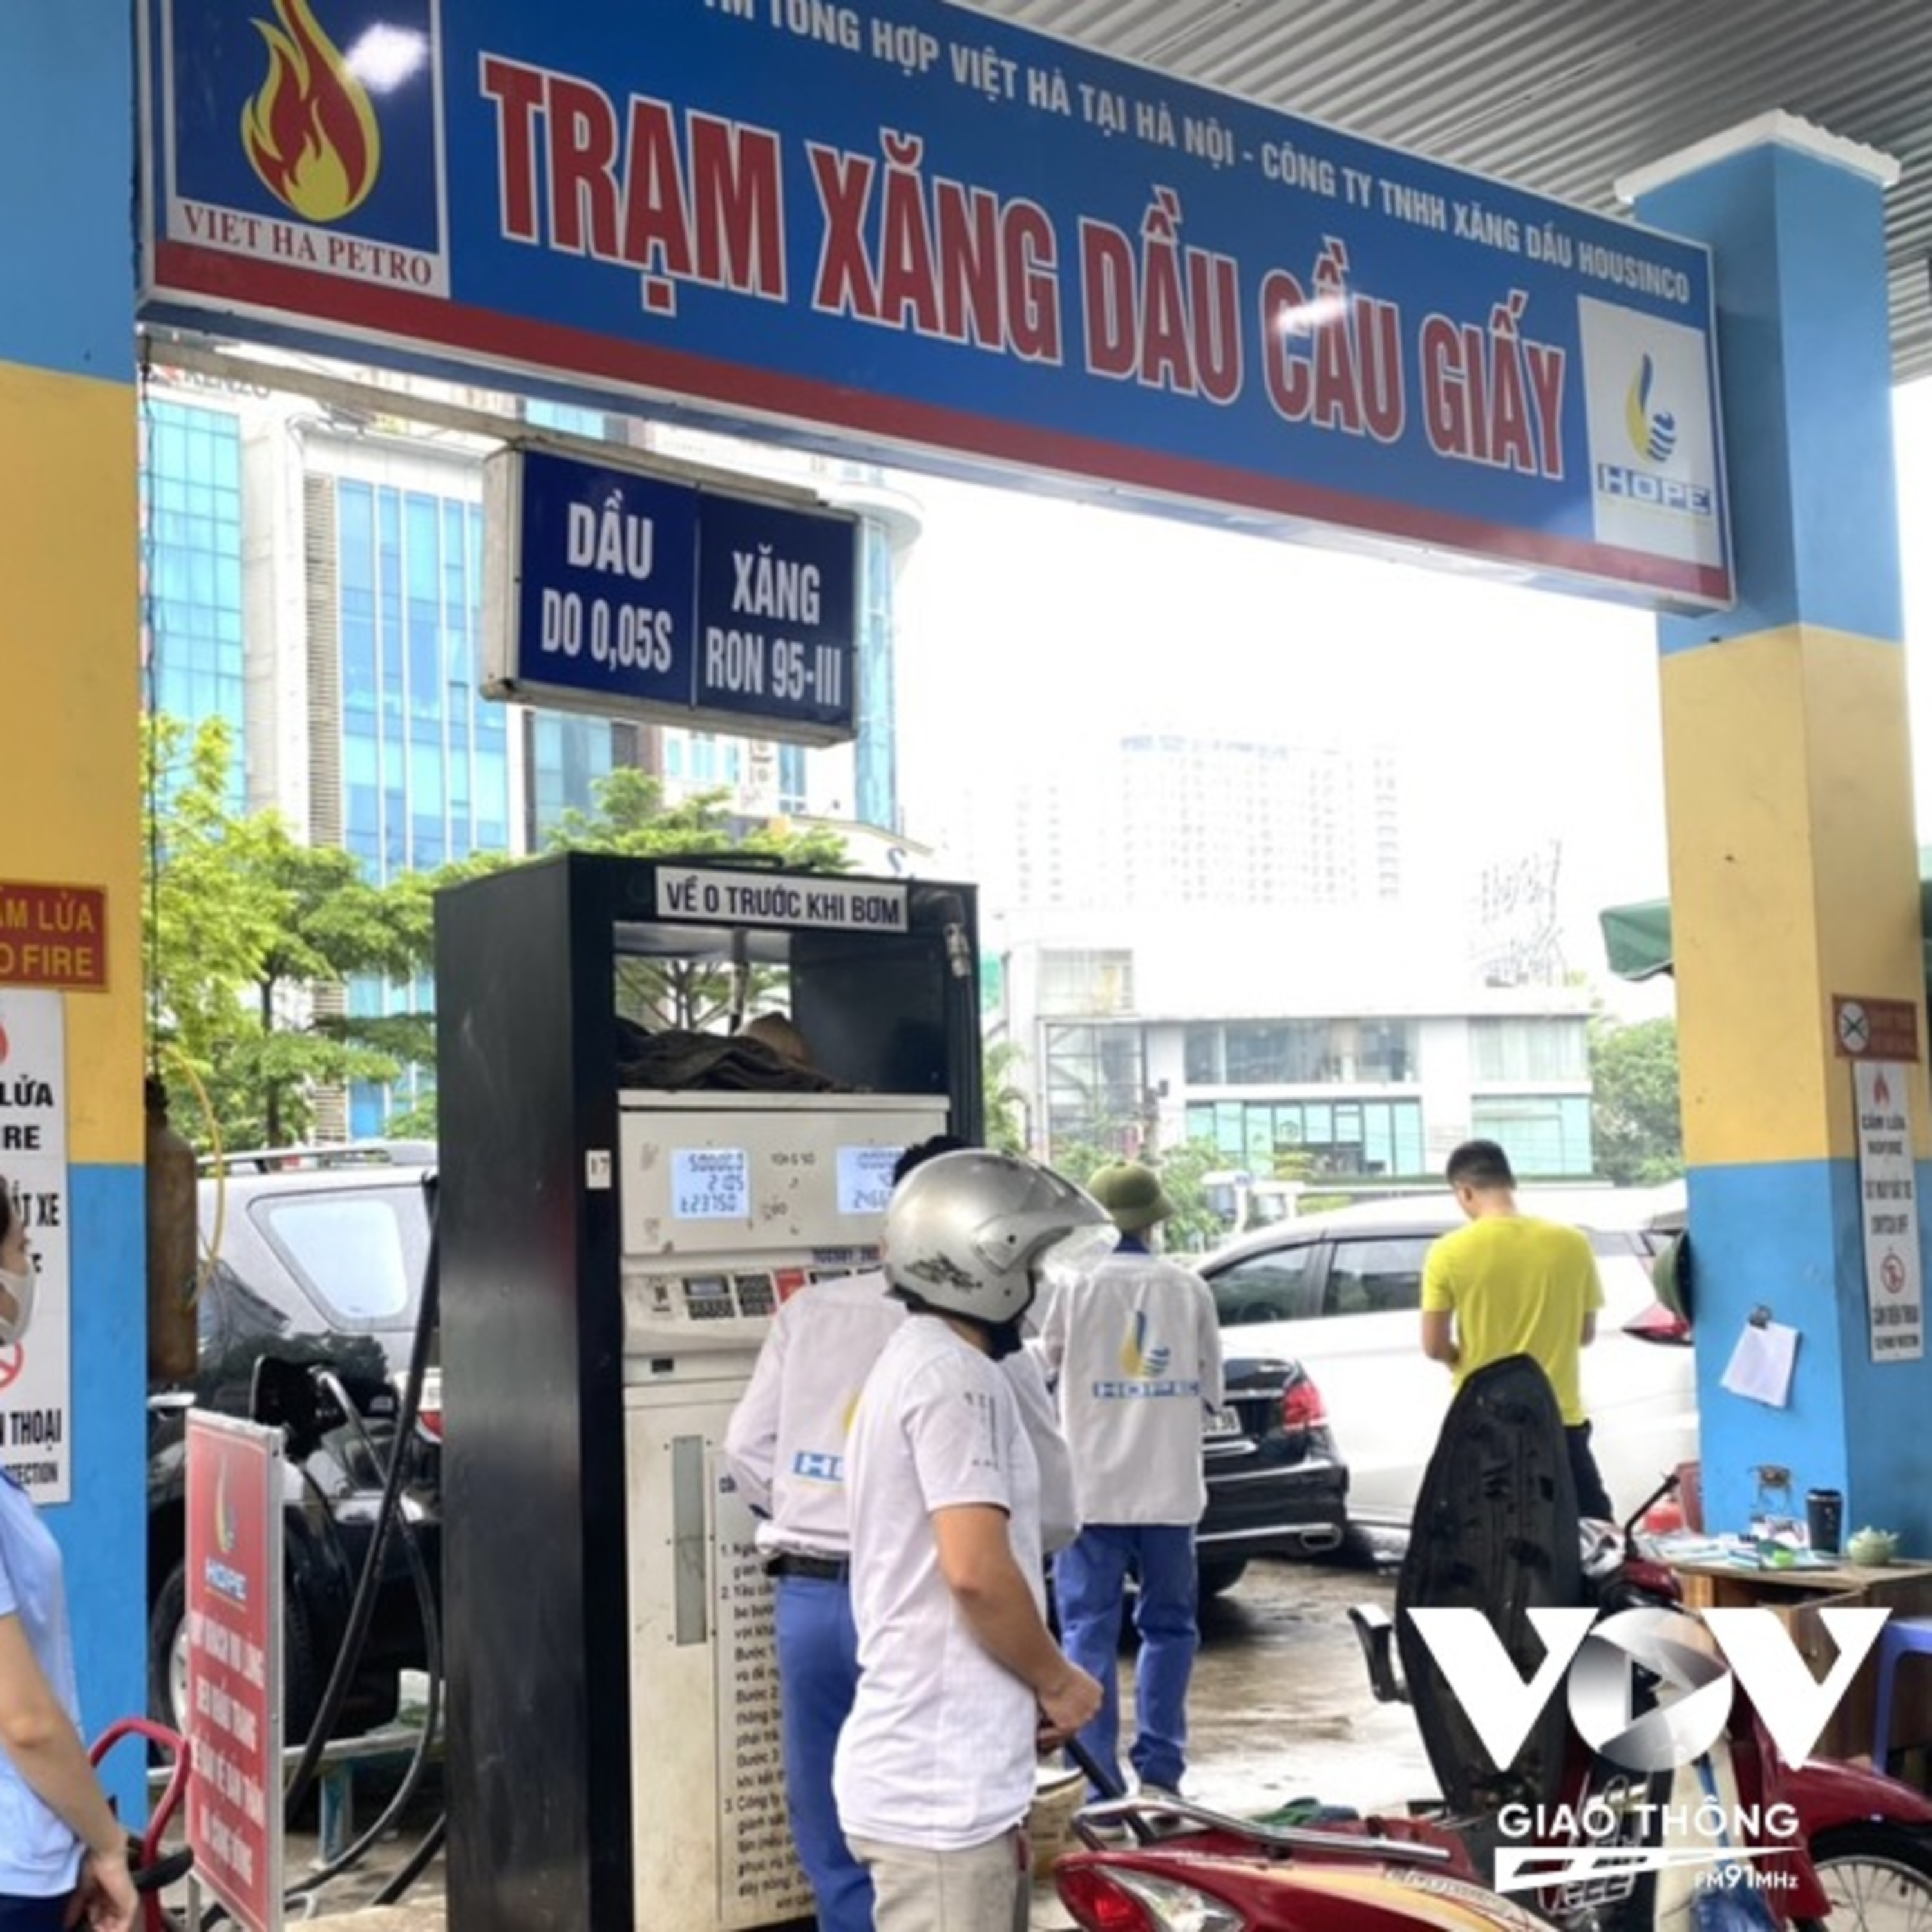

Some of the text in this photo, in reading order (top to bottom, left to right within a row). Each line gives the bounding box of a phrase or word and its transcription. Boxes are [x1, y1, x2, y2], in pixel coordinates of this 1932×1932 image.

[871, 18, 939, 77] HỢP
[949, 43, 1017, 104] VIỆT
[1028, 67, 1070, 117] HÀ
[1078, 83, 1126, 137] TẠI
[1136, 100, 1176, 148] HÀ
[1183, 116, 1235, 170] NỘI
[1261, 141, 1336, 197] CÔNG
[1342, 167, 1373, 209] TY
[1379, 179, 1446, 231] TNHH
[1453, 202, 1520, 253] XĂNG
[1578, 240, 1690, 305] HOUSINCO
[184, 205, 432, 286] VIET HA PETRO
[478, 51, 1566, 482] TRẠM XĂNG DẦU CẦU GIẤY
[1598, 464, 1712, 515] HOPE
[567, 488, 653, 579] DẦU
[732, 543, 820, 625] XĂNG
[541, 588, 672, 672] DO 0,05S
[706, 627, 842, 706] RON 95-III
[38, 890, 95, 933] LỬA
[725, 883, 801, 919] TRƯỚC
[806, 892, 846, 921] KHI
[851, 895, 900, 925] BƠM
[23, 944, 94, 977] FIRE
[36, 1193, 59, 1227] XE
[10, 1408, 62, 1452] THOẠI
